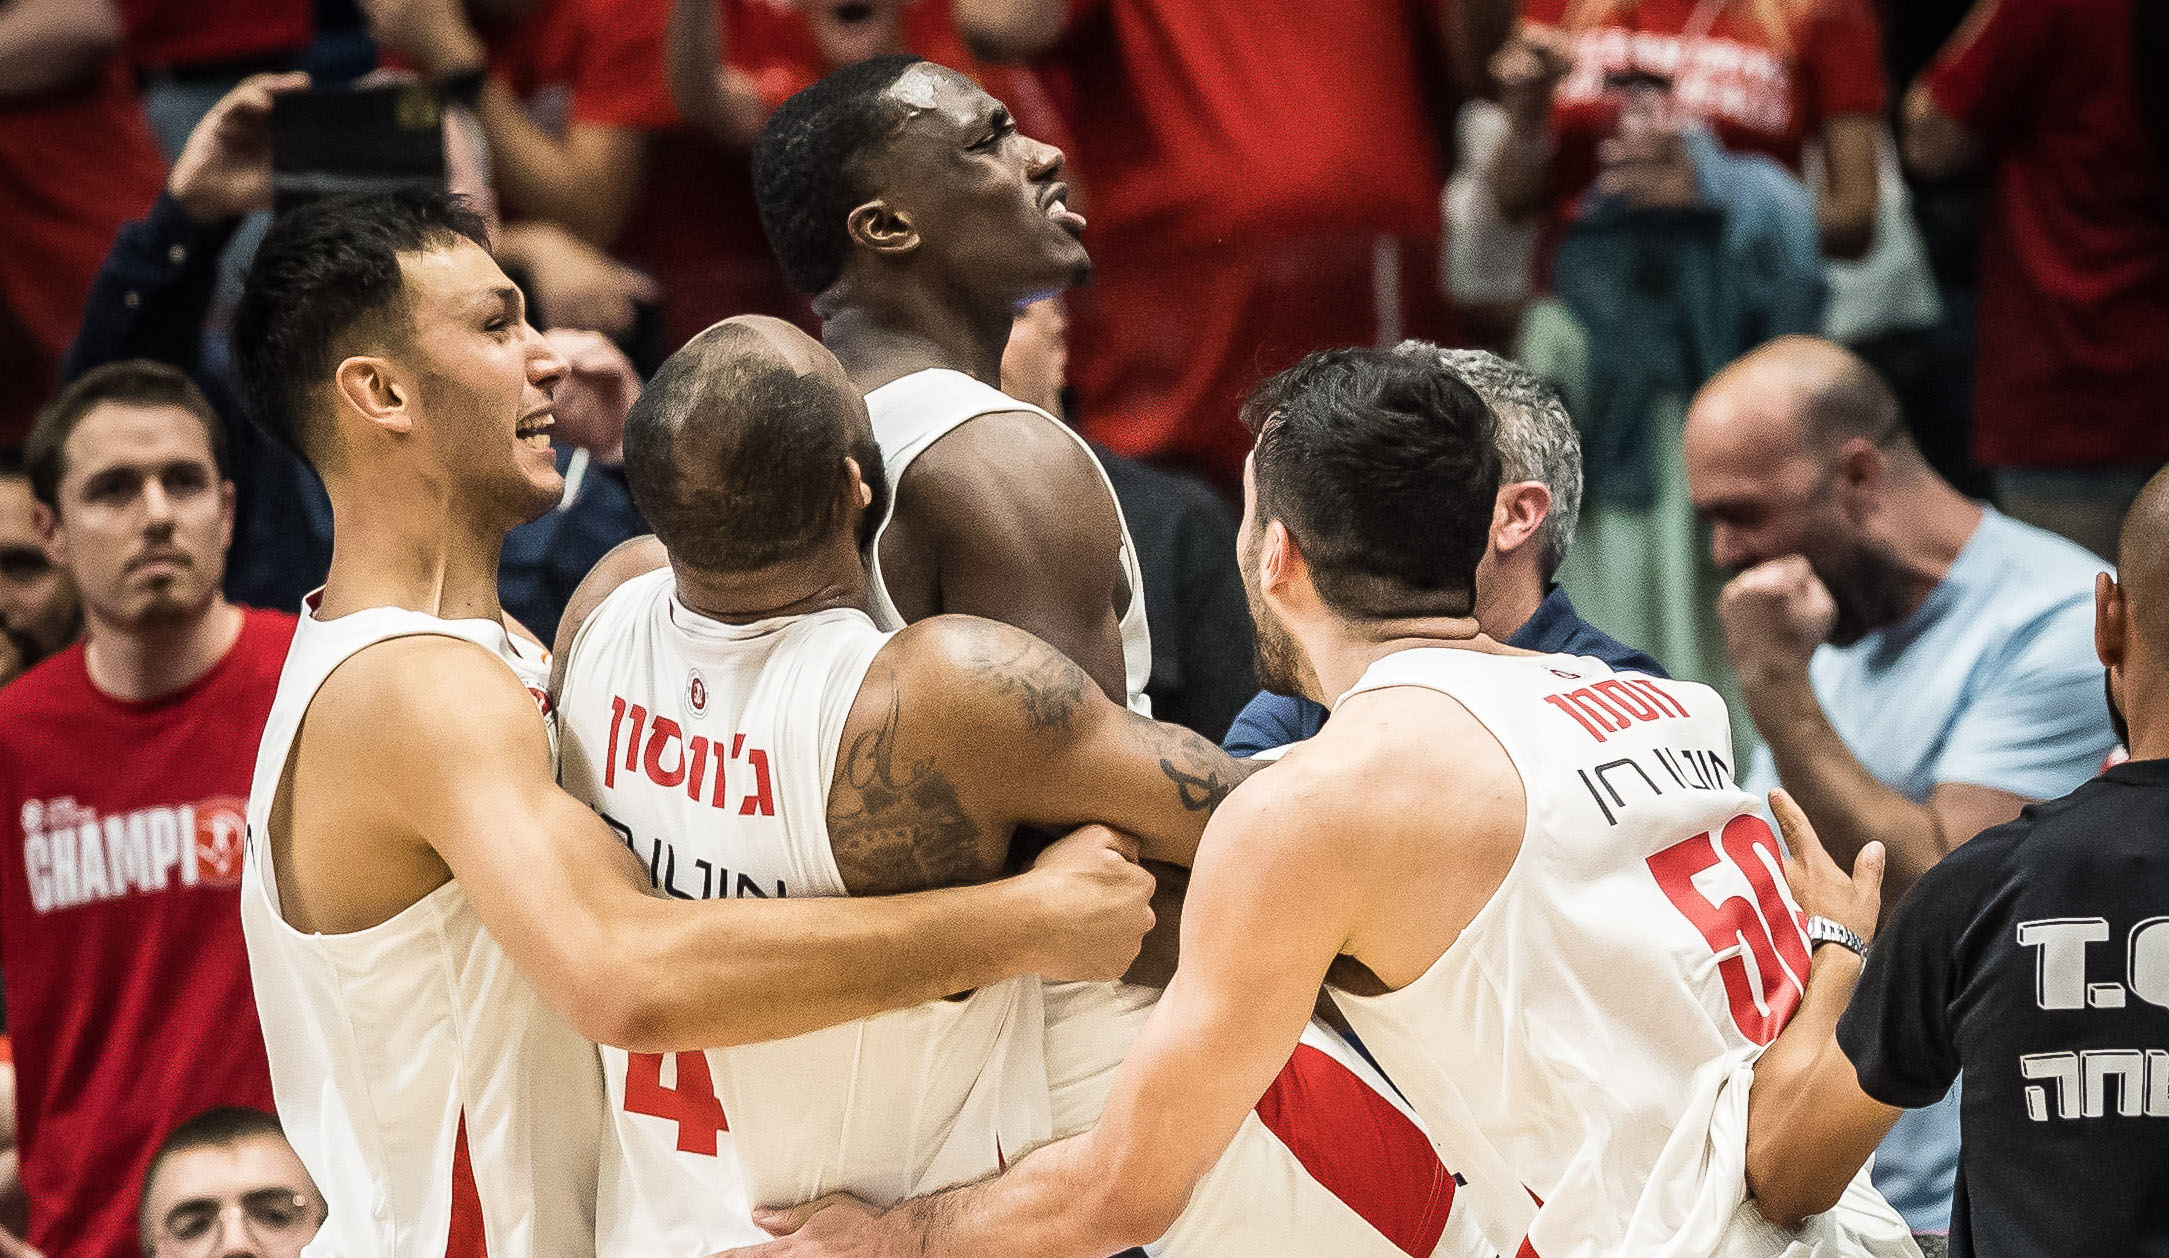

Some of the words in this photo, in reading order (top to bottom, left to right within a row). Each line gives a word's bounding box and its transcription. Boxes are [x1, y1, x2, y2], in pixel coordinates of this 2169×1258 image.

[1544, 679, 1691, 743] זוסמן
[1577, 758, 1663, 827] חן
[23, 803, 247, 914] CHAMPI
[1645, 813, 1813, 1048] 50
[623, 1050, 730, 1157] 4
